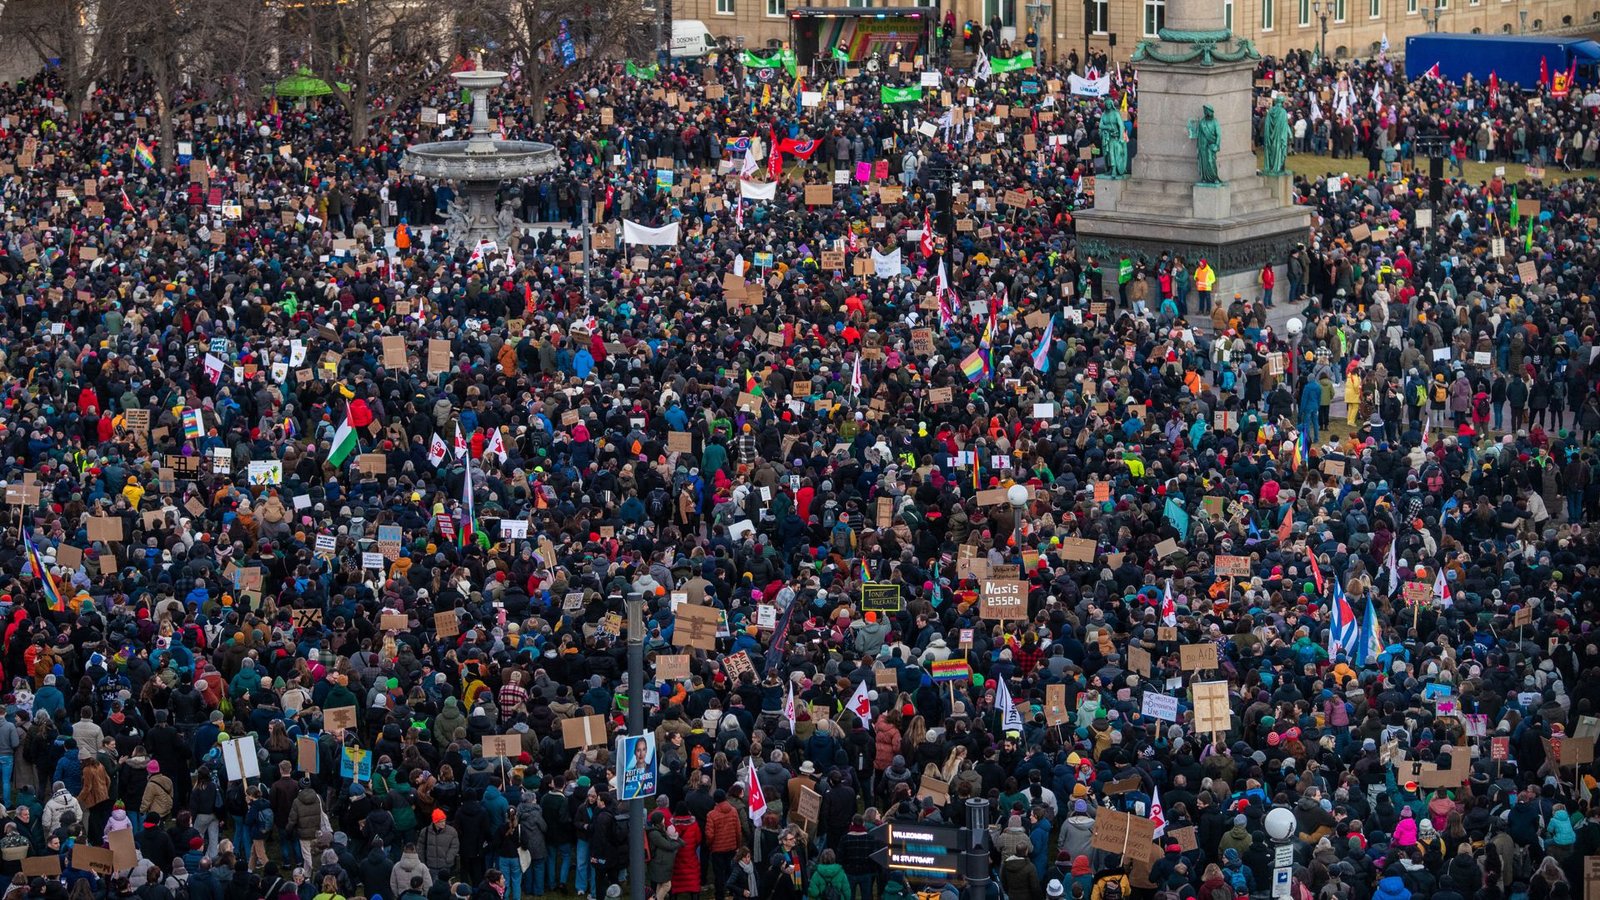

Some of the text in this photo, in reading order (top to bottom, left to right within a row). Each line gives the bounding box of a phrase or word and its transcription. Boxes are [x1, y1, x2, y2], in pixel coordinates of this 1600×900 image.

[985, 582, 1019, 594] Nazis
[988, 596, 1021, 606] essen
[1197, 648, 1215, 660] AfD
[723, 657, 739, 682] DIGGA
[626, 768, 637, 777] ZEIT
[626, 775, 639, 783] ALICE
[643, 782, 654, 791] AfD
[892, 831, 934, 841] WILLKOMMEN
[892, 854, 935, 865] IN STUTTGART
